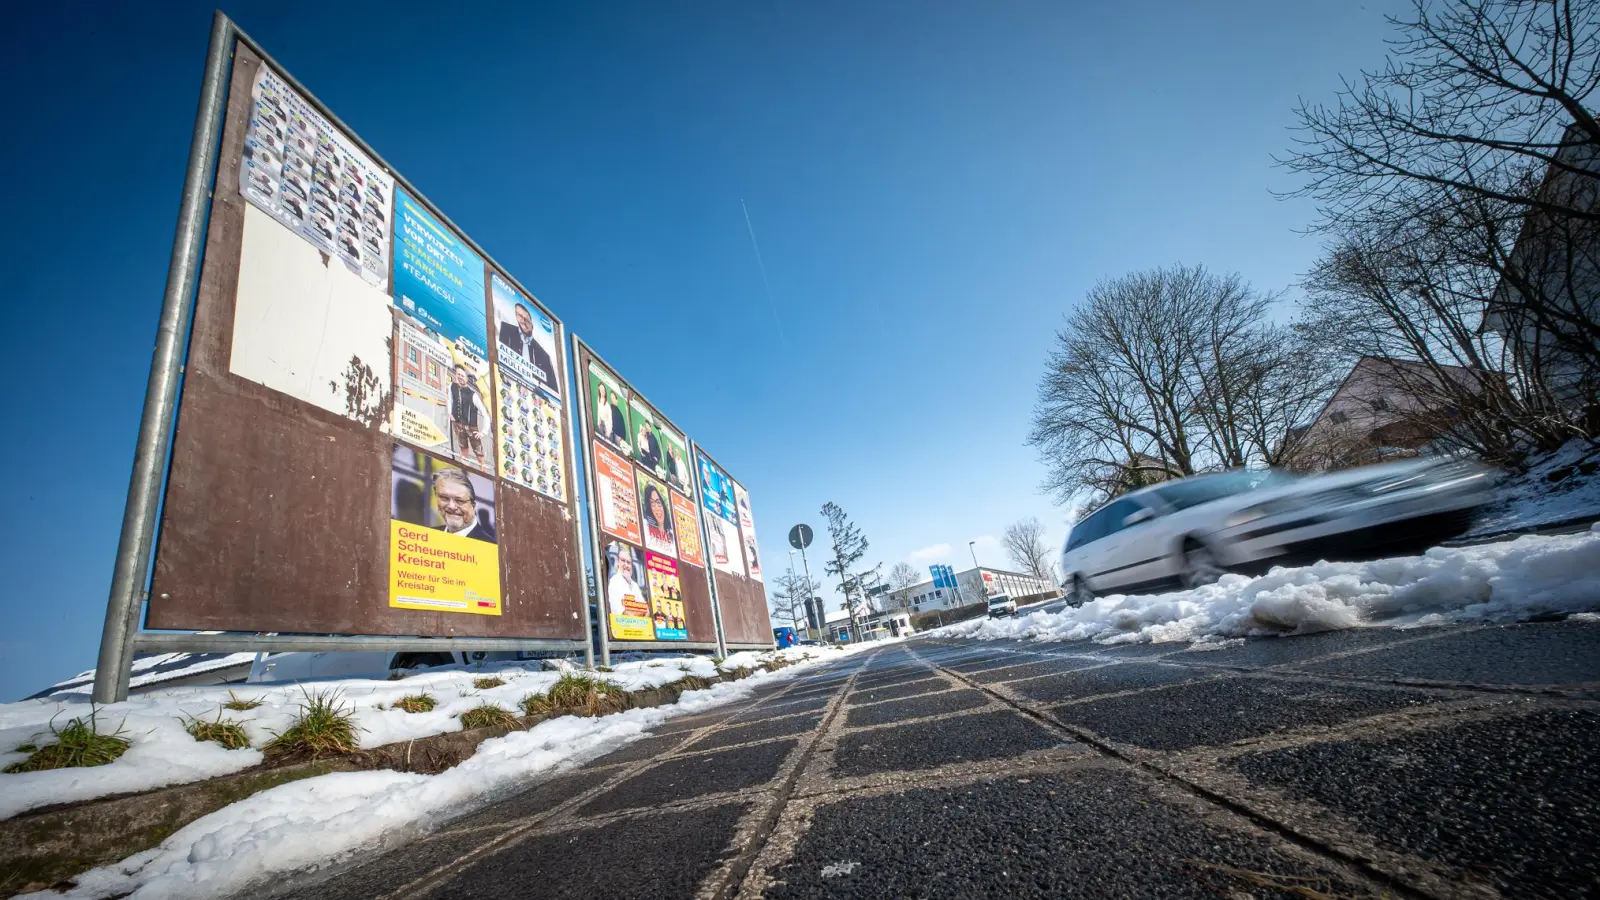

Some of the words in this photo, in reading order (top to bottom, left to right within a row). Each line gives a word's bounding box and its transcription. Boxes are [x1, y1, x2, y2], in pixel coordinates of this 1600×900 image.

[265, 71, 282, 86] Ihr
[283, 86, 334, 134] #TeamCSU
[265, 79, 280, 95] für
[283, 95, 298, 111] die
[299, 109, 367, 171] Kommunalwahl
[368, 168, 389, 190] 2026
[247, 187, 283, 216] CSU
[403, 223, 425, 247] VOR
[426, 243, 447, 265] ORT.
[403, 237, 463, 288] GEMEINSAM
[403, 262, 455, 304] #TEAMCSU
[403, 332, 428, 351] Harald
[428, 348, 447, 364] Haag
[499, 344, 546, 379] ALEXANDER
[500, 353, 532, 379] MÜLLER
[401, 414, 429, 431] Energie
[398, 527, 429, 542] Gerd
[397, 552, 445, 570] Kreisrat
[398, 540, 478, 566] Scheuenstuhl,
[397, 570, 426, 581] Weiter
[428, 574, 440, 583] für
[442, 576, 454, 585] Sie
[456, 578, 466, 587] im
[397, 580, 435, 593] Kreistag
